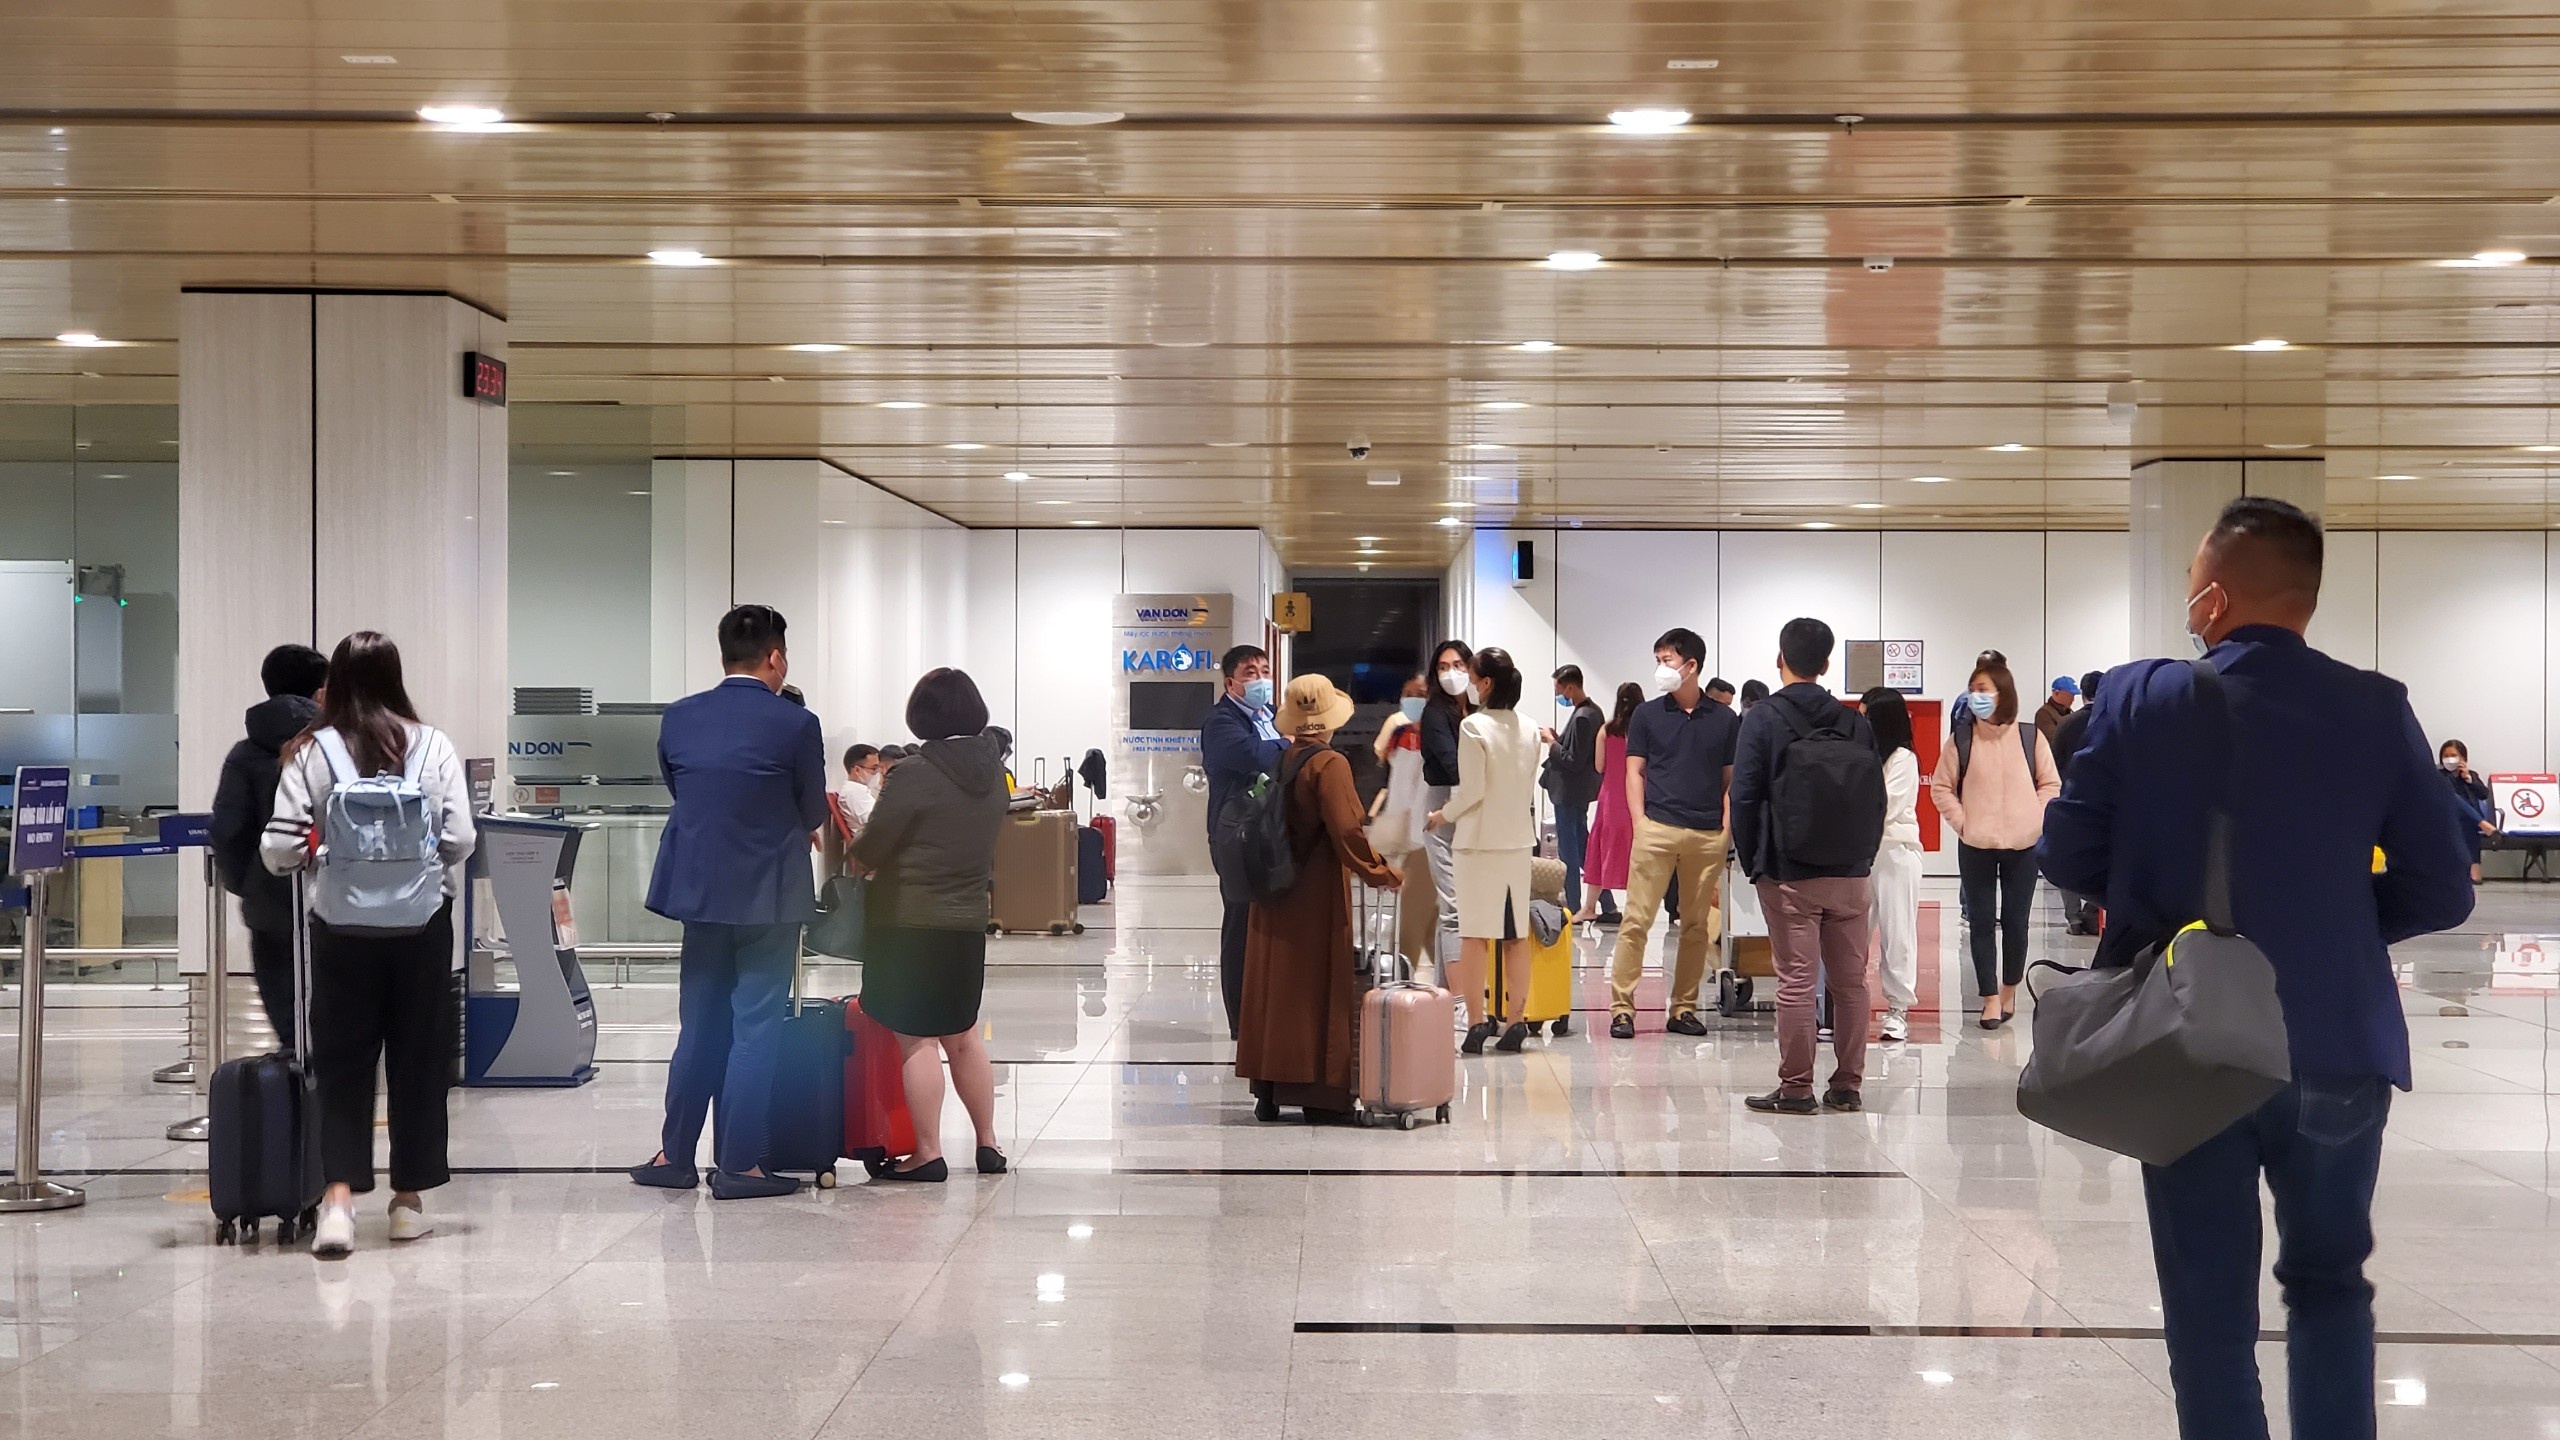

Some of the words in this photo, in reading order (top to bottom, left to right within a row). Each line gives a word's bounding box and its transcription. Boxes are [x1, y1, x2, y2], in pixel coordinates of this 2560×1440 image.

[1136, 609, 1160, 617] VAN
[1163, 609, 1188, 617] DON
[1122, 643, 1211, 671] KAROFI
[1295, 722, 1326, 732] adidas
[525, 741, 563, 755] DON
